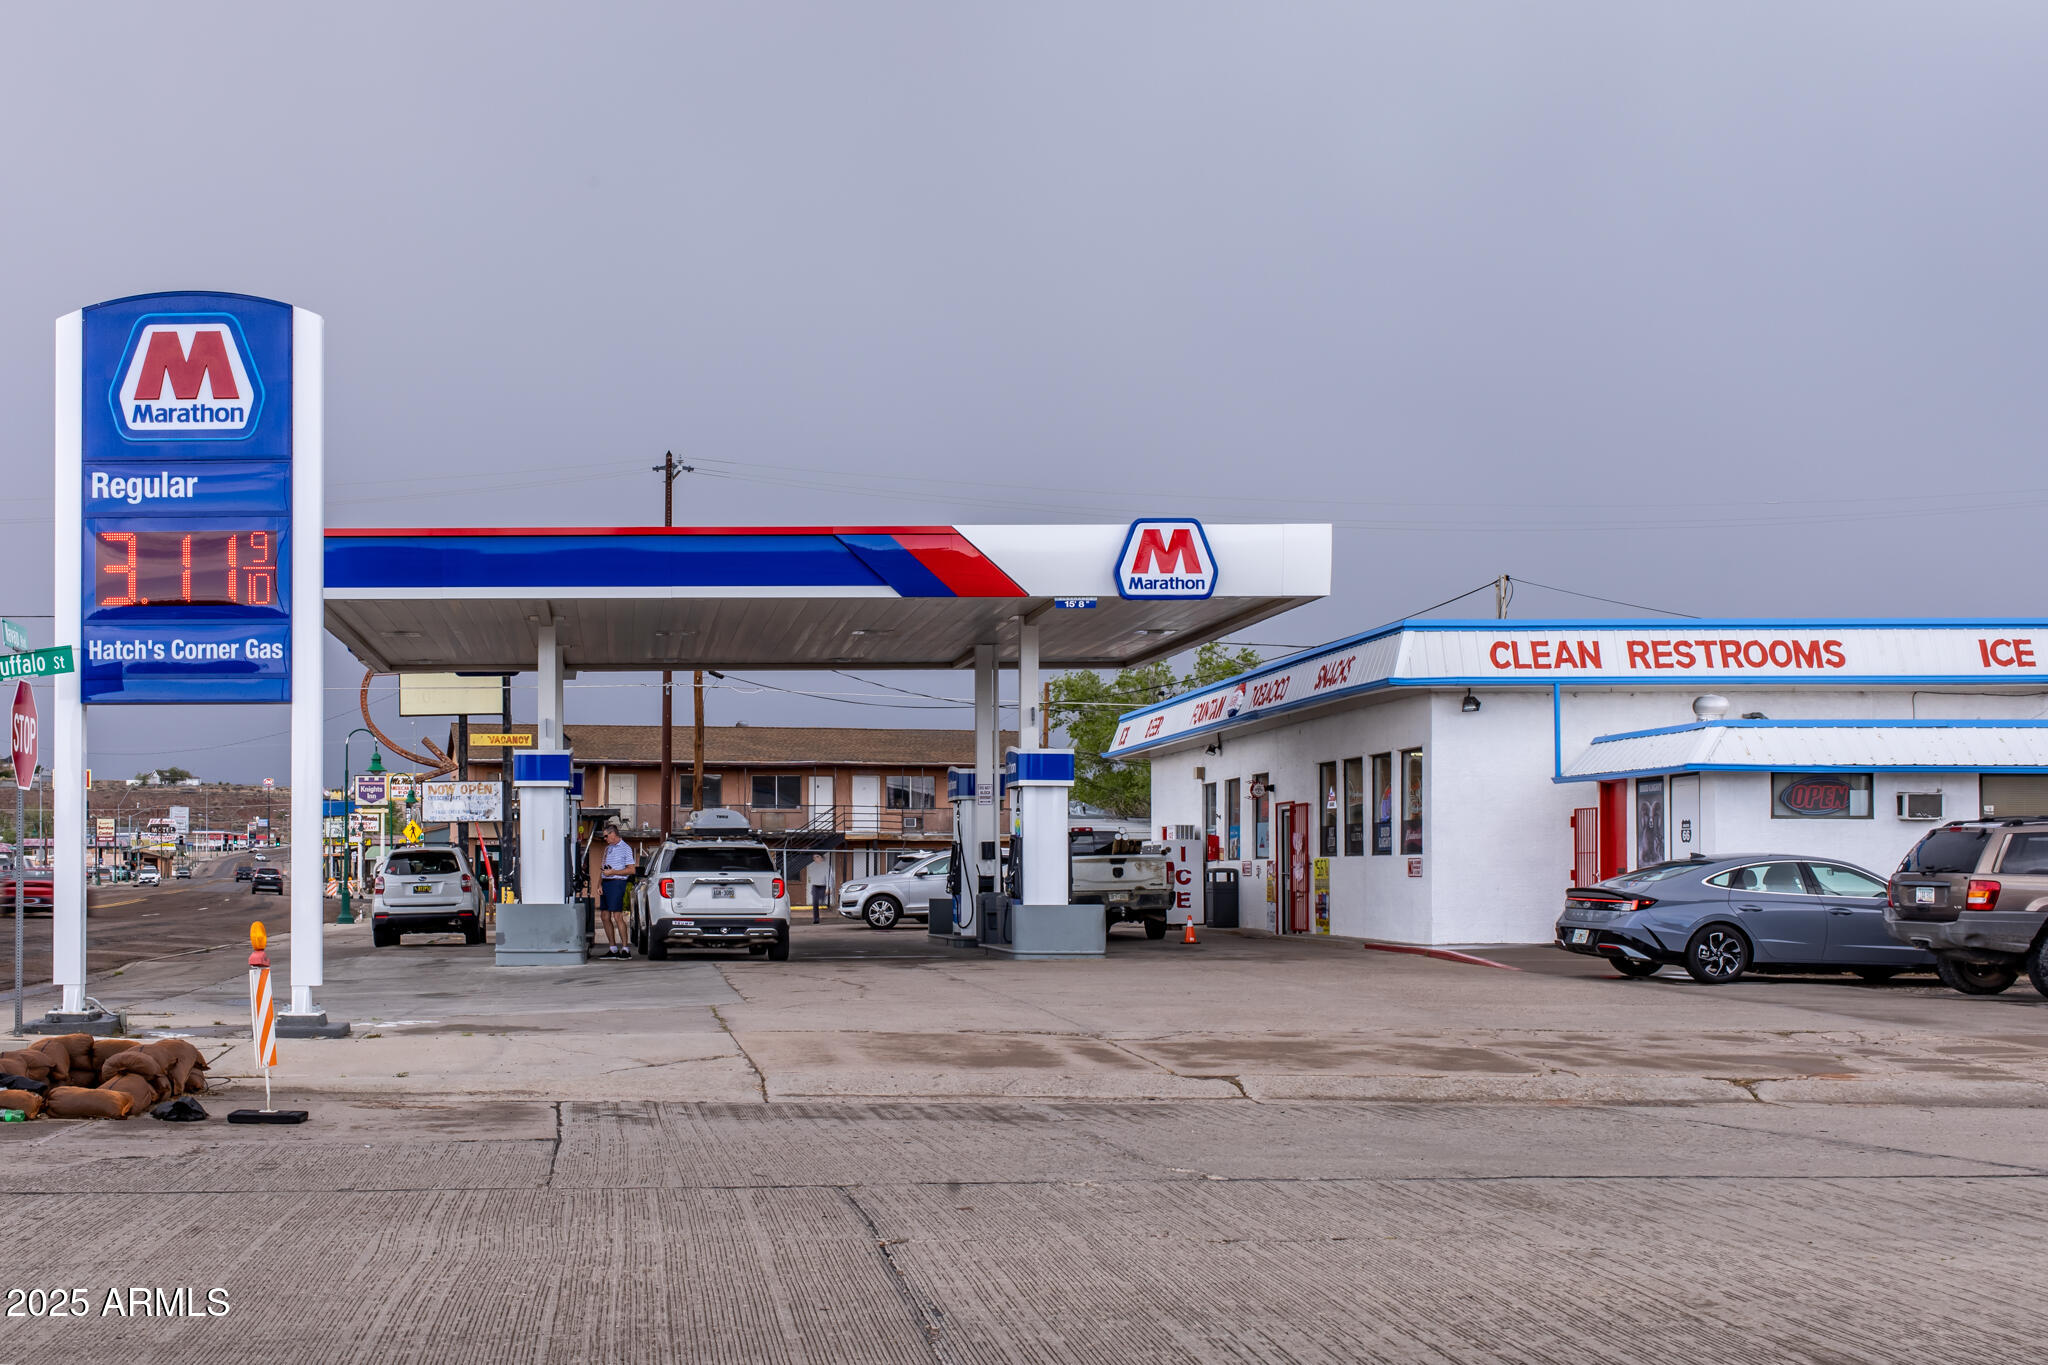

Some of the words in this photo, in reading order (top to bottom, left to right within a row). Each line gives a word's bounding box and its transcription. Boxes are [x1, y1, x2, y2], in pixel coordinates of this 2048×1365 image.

[132, 404, 244, 424] Marathon
[91, 471, 199, 504] Regular
[1128, 577, 1205, 590] Marathon
[88, 639, 165, 660] Hatch's
[171, 639, 239, 660] Corner
[245, 638, 283, 659] Gas
[1489, 639, 1603, 670] CLEAN
[1626, 639, 1846, 670] RESTROOMS
[1978, 638, 2036, 669] ICE
[0, 653, 46, 676] uffalo
[53, 655, 66, 670] St
[1249, 676, 1291, 708] TOBACCO
[1314, 655, 1356, 691] SNACKS
[13, 713, 37, 755] STOP
[487, 735, 530, 745] VACANCY
[360, 786, 383, 794] Knights
[427, 784, 457, 795] NOW
[460, 784, 493, 795] OPEN
[1791, 784, 1849, 809] OPEN
[1175, 846, 1192, 909] ICE
